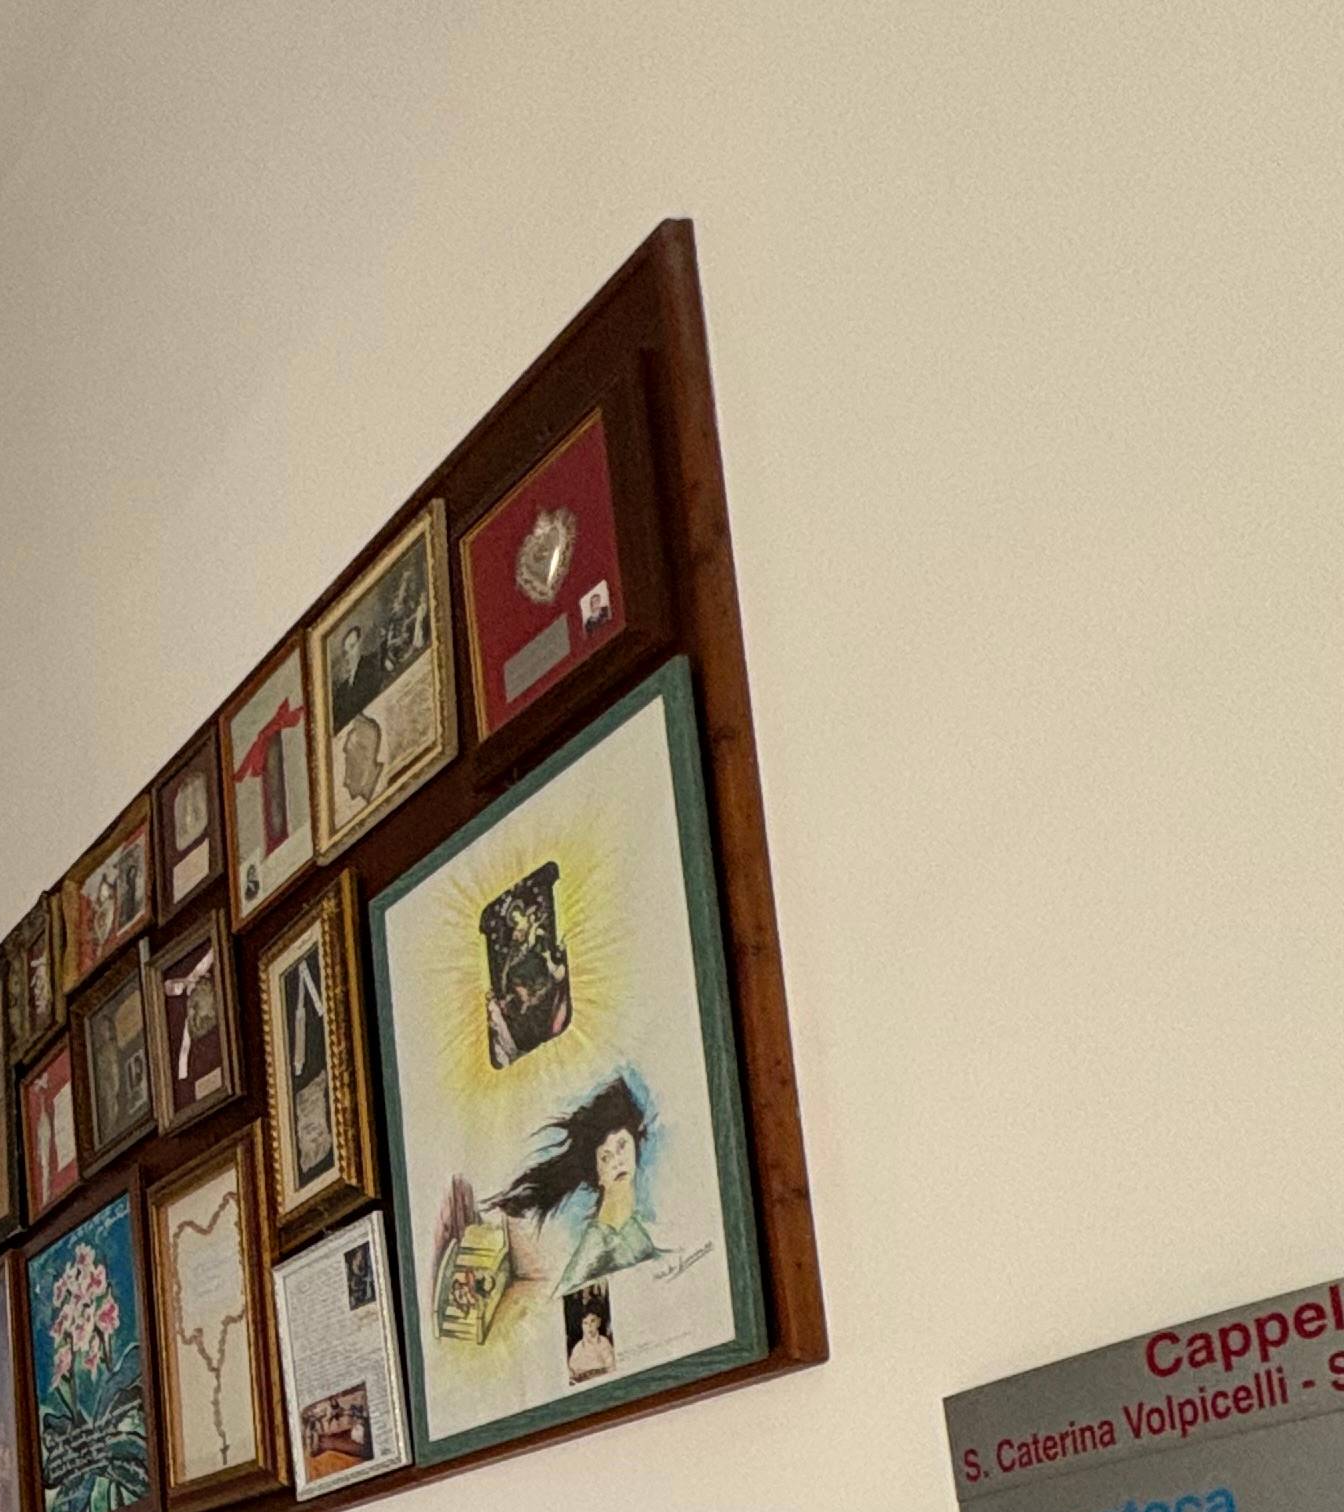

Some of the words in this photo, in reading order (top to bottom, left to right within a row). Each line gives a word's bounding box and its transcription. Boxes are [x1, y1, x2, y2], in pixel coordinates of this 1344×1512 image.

[963, 1447, 990, 1483] S.
[996, 1415, 1116, 1476] Caterina
[1123, 1365, 1289, 1439] Volpicelli
[1301, 1379, 1317, 1390] -
